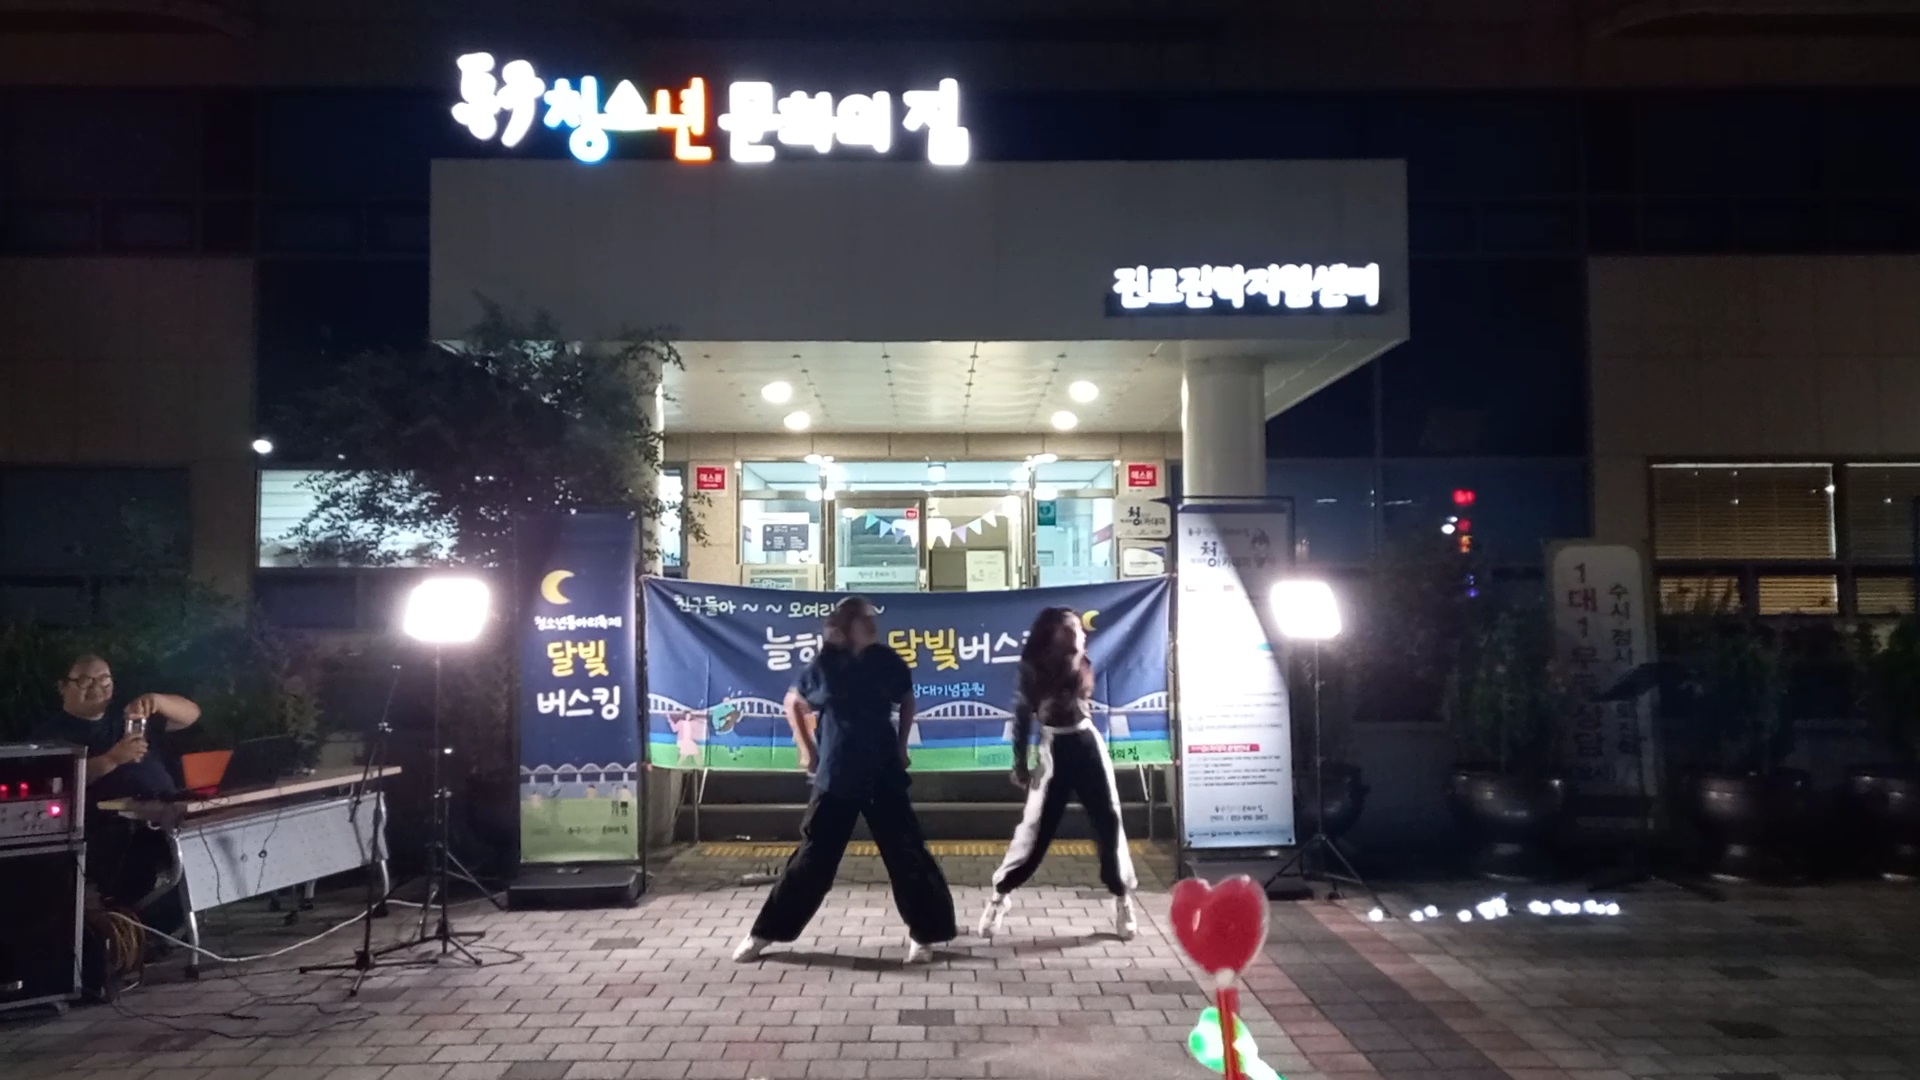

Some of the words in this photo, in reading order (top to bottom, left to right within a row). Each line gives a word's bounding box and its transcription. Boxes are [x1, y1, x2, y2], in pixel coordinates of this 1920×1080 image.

[718, 81, 891, 163] 문화의
[903, 78, 969, 166] 집
[546, 638, 610, 678] 달빛
[536, 684, 621, 720] 버스킹
